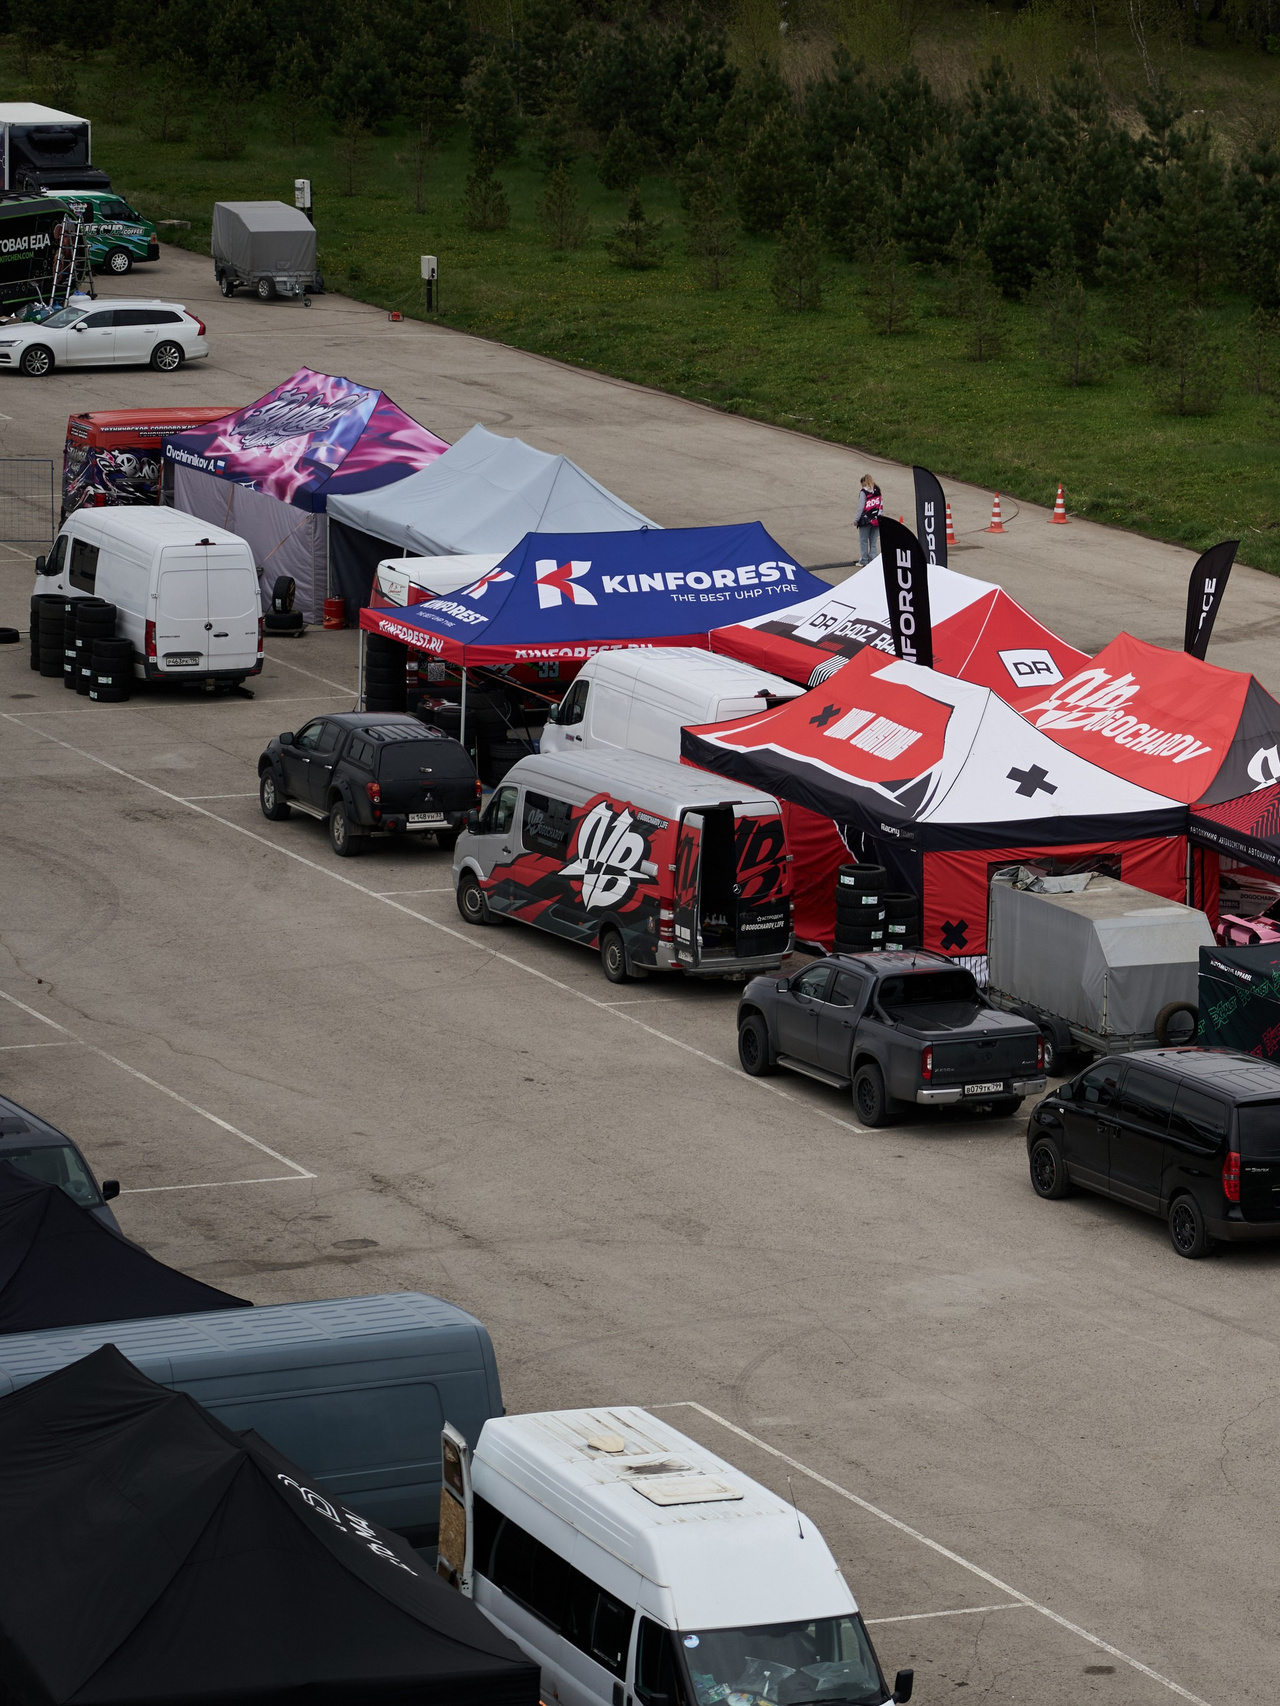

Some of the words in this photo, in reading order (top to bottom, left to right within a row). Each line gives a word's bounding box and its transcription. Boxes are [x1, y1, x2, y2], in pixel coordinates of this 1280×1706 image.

[30, 233, 51, 250] ЕДА
[166, 444, 208, 471] Ovchinnikov
[601, 560, 797, 594] KINFOREST
[670, 594, 697, 603] THE
[699, 591, 732, 603] BEST
[734, 588, 763, 601] UHP
[765, 583, 799, 596] TYRE
[809, 613, 838, 631] DR
[834, 620, 877, 643] DADZ
[379, 619, 444, 653] KINFOREST.RU
[1013, 660, 1053, 676] DR
[1248, 847, 1276, 864] АВТОХИМИЯ
[966, 1085, 991, 1094] В079ТК
